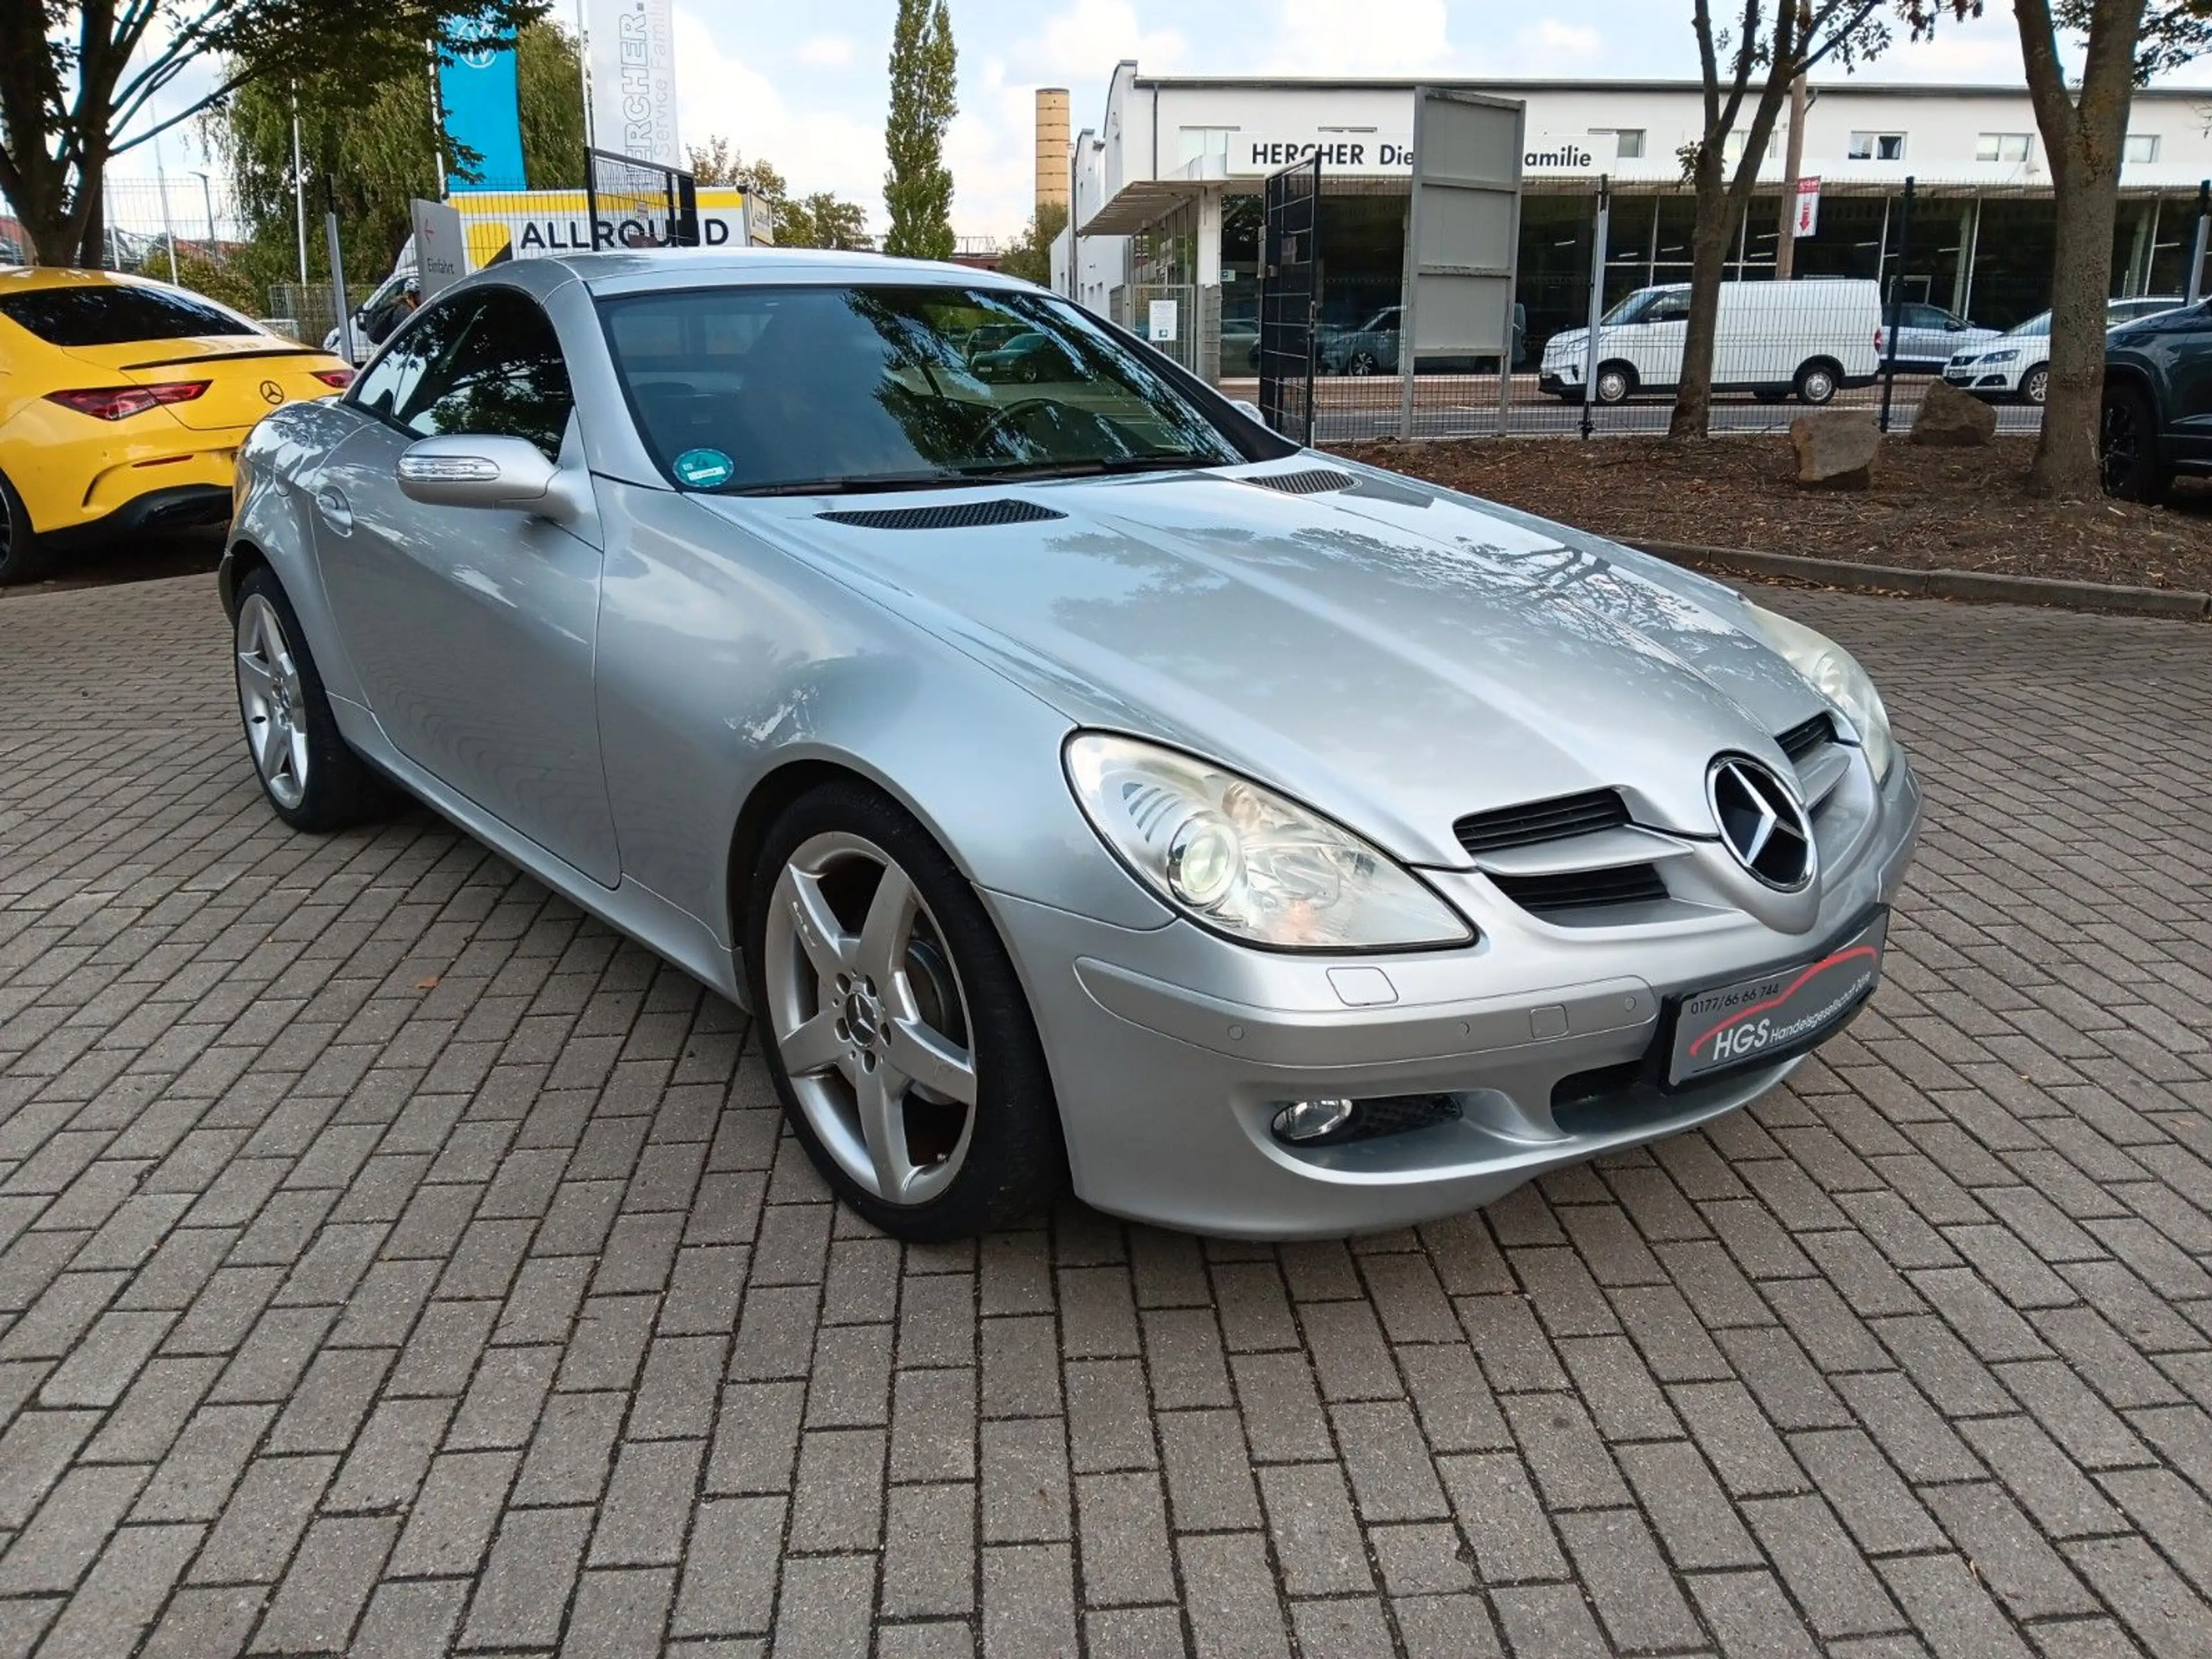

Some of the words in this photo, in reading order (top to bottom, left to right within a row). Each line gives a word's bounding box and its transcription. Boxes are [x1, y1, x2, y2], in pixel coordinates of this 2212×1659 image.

[647, 0, 668, 71] Famili
[653, 79, 671, 158] Service
[1524, 145, 1592, 167] amilie
[520, 218, 729, 249] ALLROUD
[427, 257, 454, 275] Einfahrt
[1691, 992, 1739, 1014] 0177/66
[1742, 988, 1757, 1003] 66
[1713, 1018, 1770, 1061] HGS
